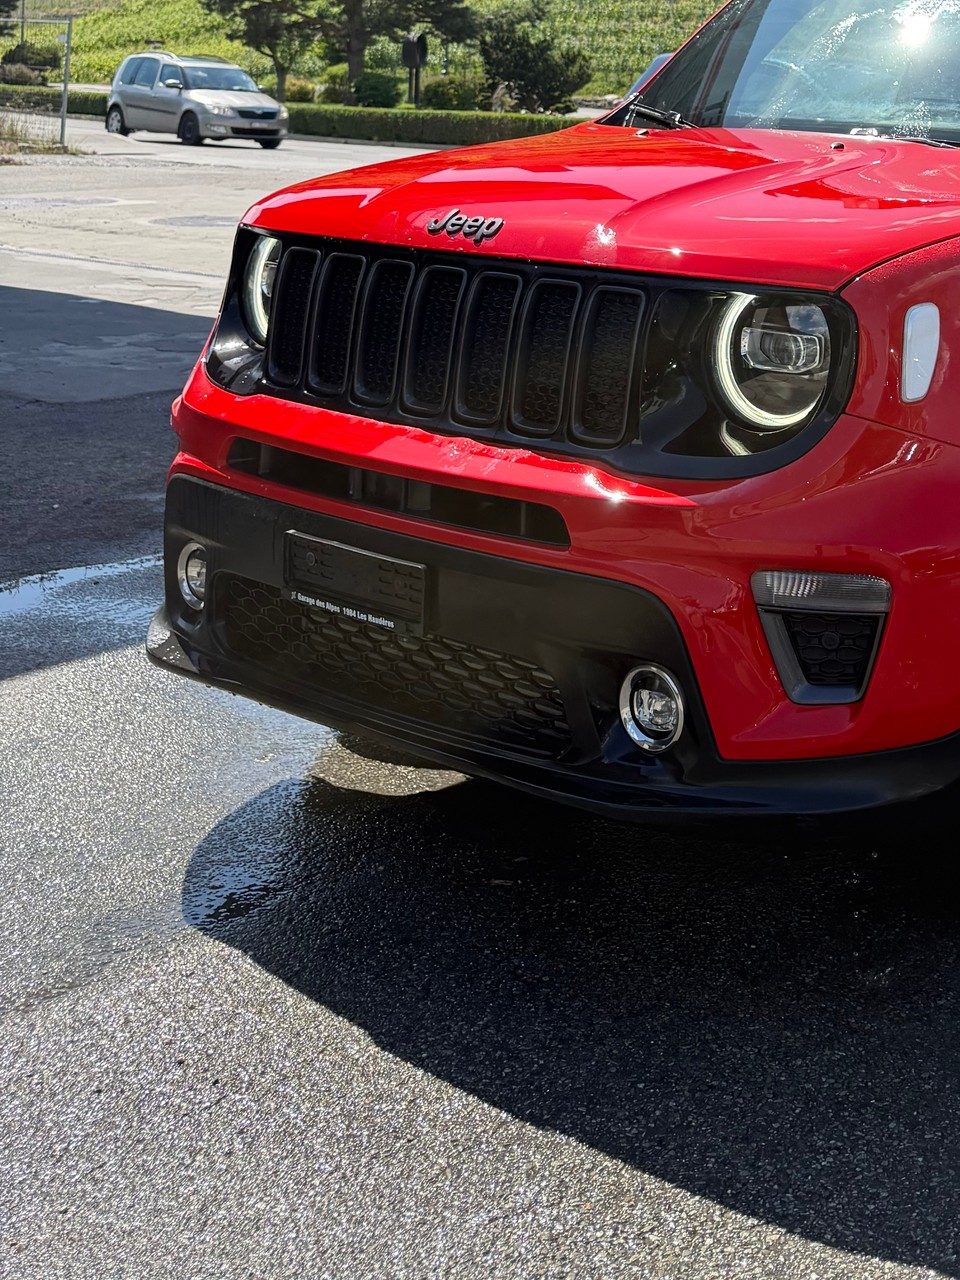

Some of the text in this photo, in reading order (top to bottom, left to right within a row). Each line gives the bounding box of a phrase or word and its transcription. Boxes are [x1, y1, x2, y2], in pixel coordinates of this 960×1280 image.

[427, 208, 504, 247] Jeep
[297, 593, 315, 605] Garage
[316, 599, 325, 609] des
[326, 602, 340, 613] Alpes
[343, 607, 356, 617] 1984
[357, 610, 367, 621] Les
